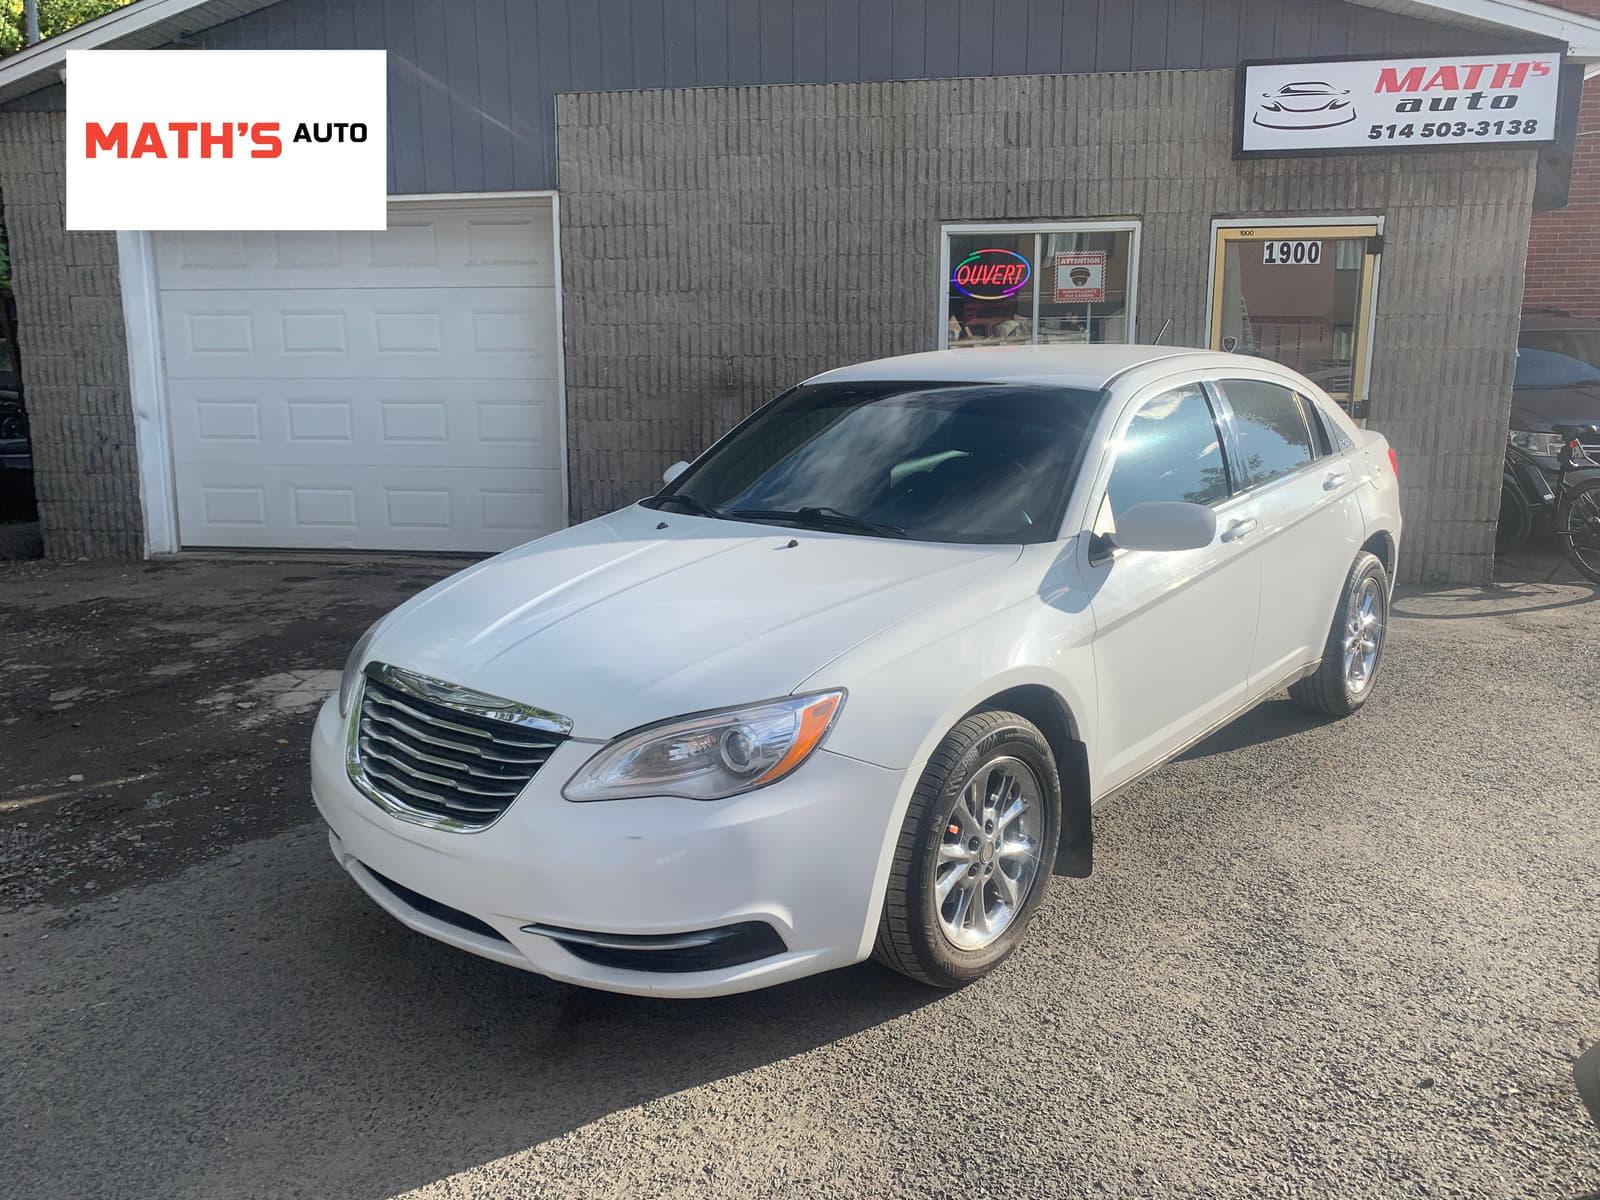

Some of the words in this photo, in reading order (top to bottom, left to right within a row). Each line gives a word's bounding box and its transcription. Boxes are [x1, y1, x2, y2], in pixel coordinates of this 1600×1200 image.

[1395, 91, 1519, 113] auto
[1368, 123, 1415, 140] 514
[1420, 119, 1538, 138] 503-3138
[1264, 242, 1320, 263] 1900
[957, 264, 1026, 285] OUVERT
